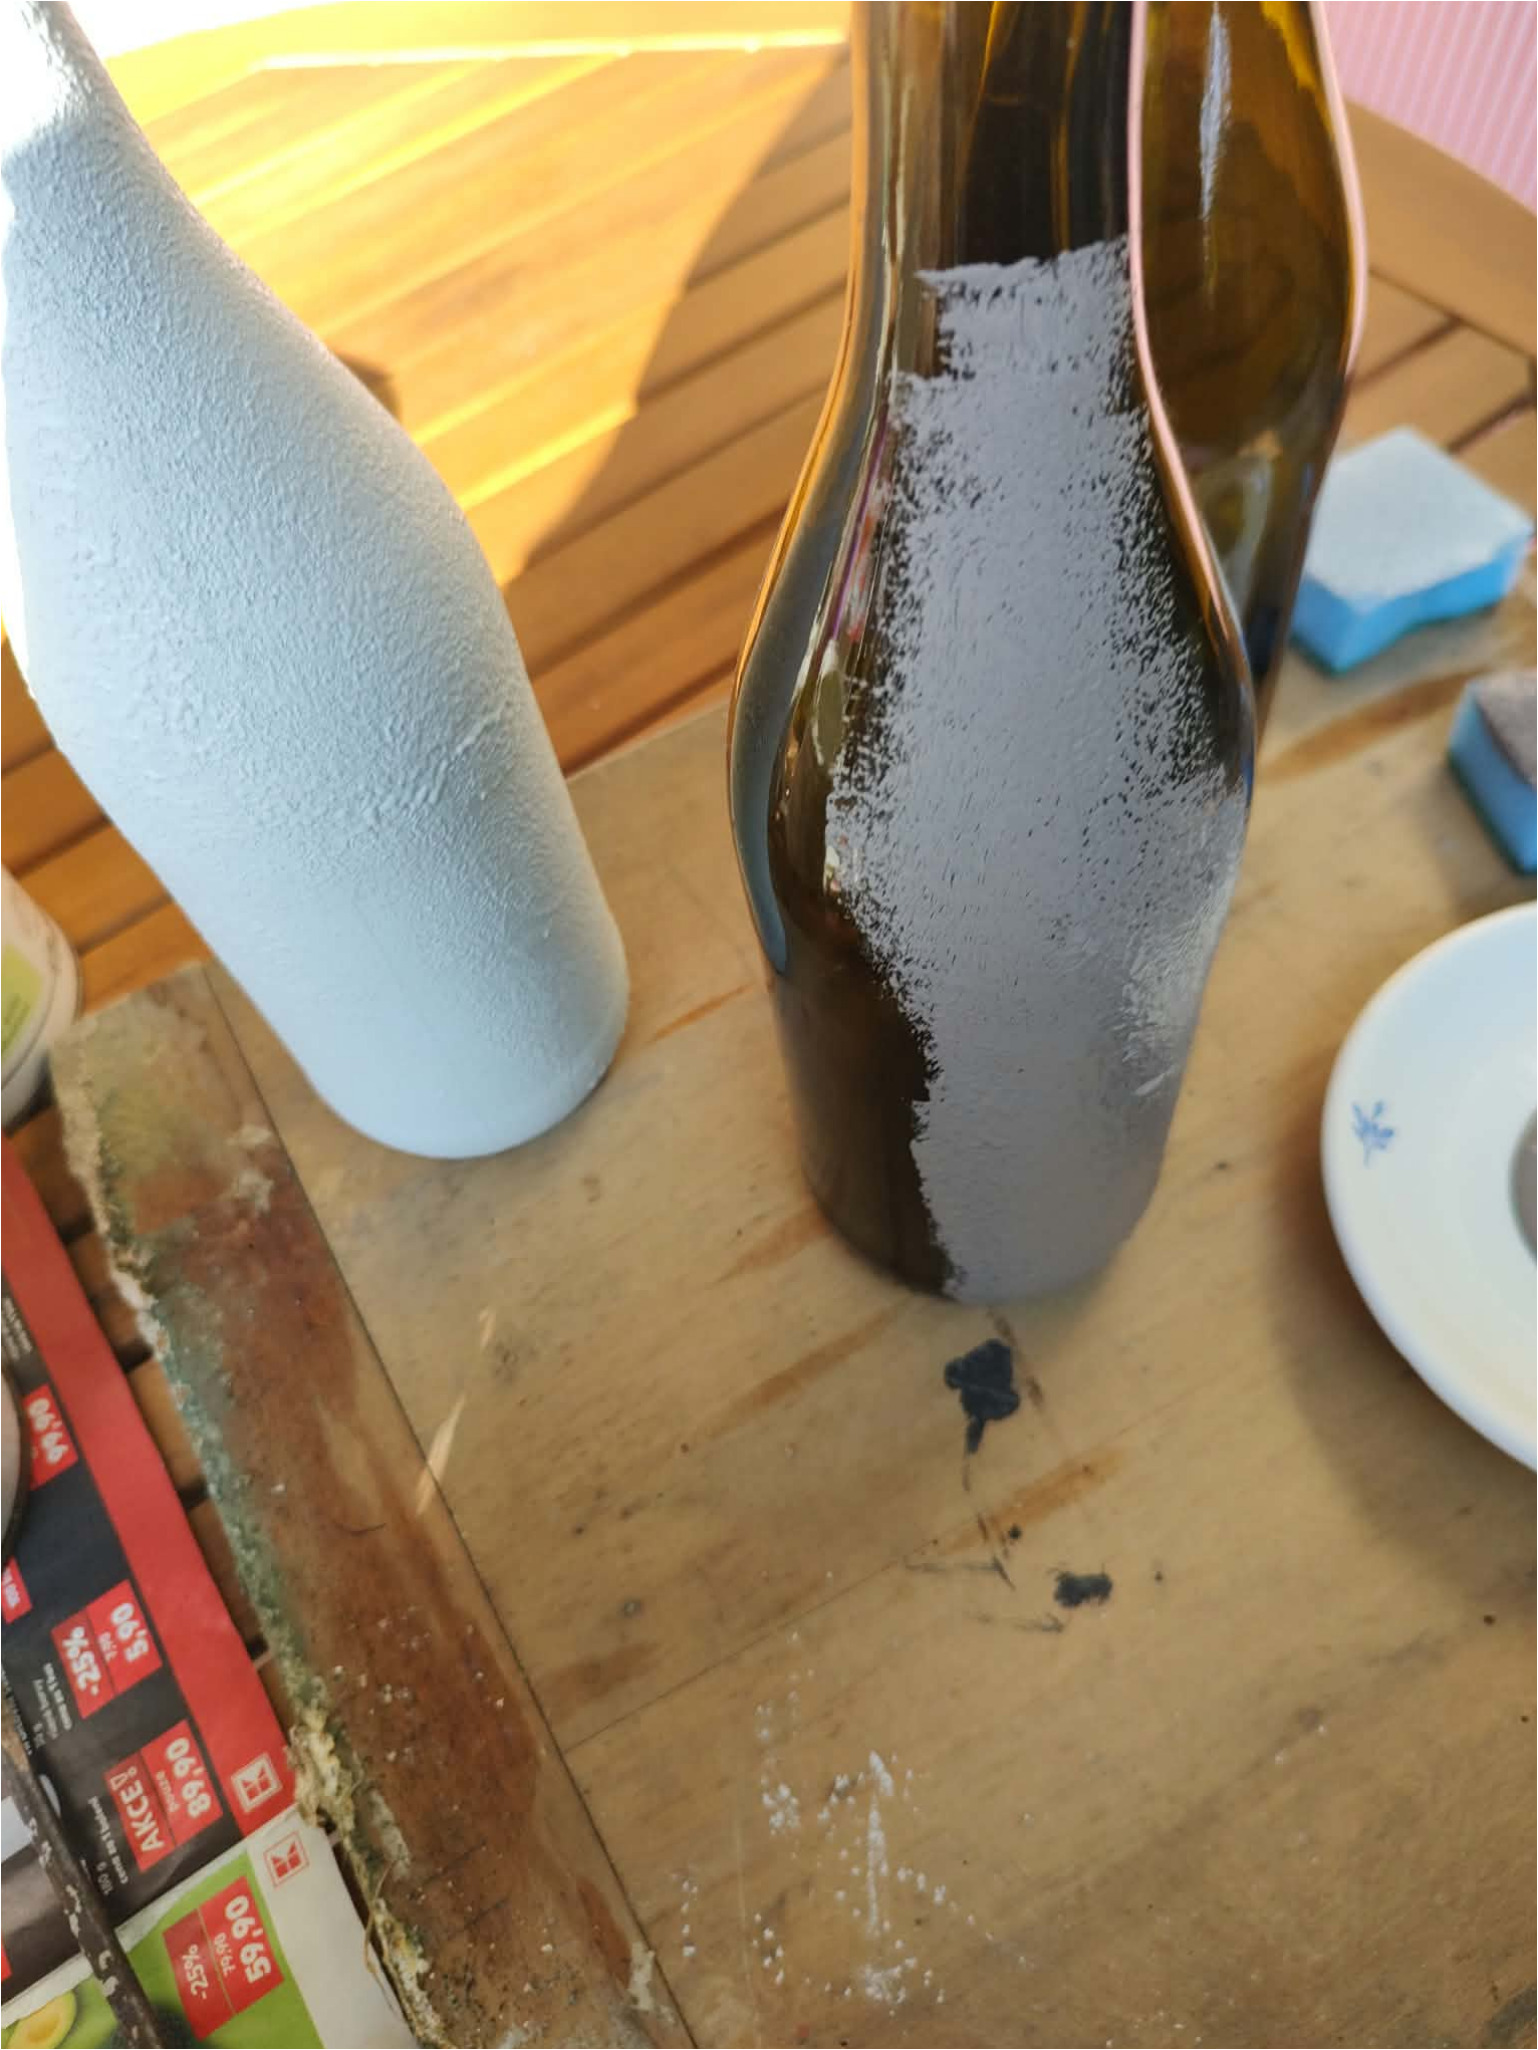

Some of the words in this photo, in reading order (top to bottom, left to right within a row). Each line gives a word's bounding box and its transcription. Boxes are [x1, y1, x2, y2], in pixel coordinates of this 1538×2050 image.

[28, 1398, 69, 1464] 99,90
[62, 1626, 101, 1696] -25%
[111, 1602, 149, 1663] 5,90
[166, 1737, 212, 1818] 89,90
[182, 1944, 208, 2000] -25%
[224, 1895, 272, 1983] 59,90
